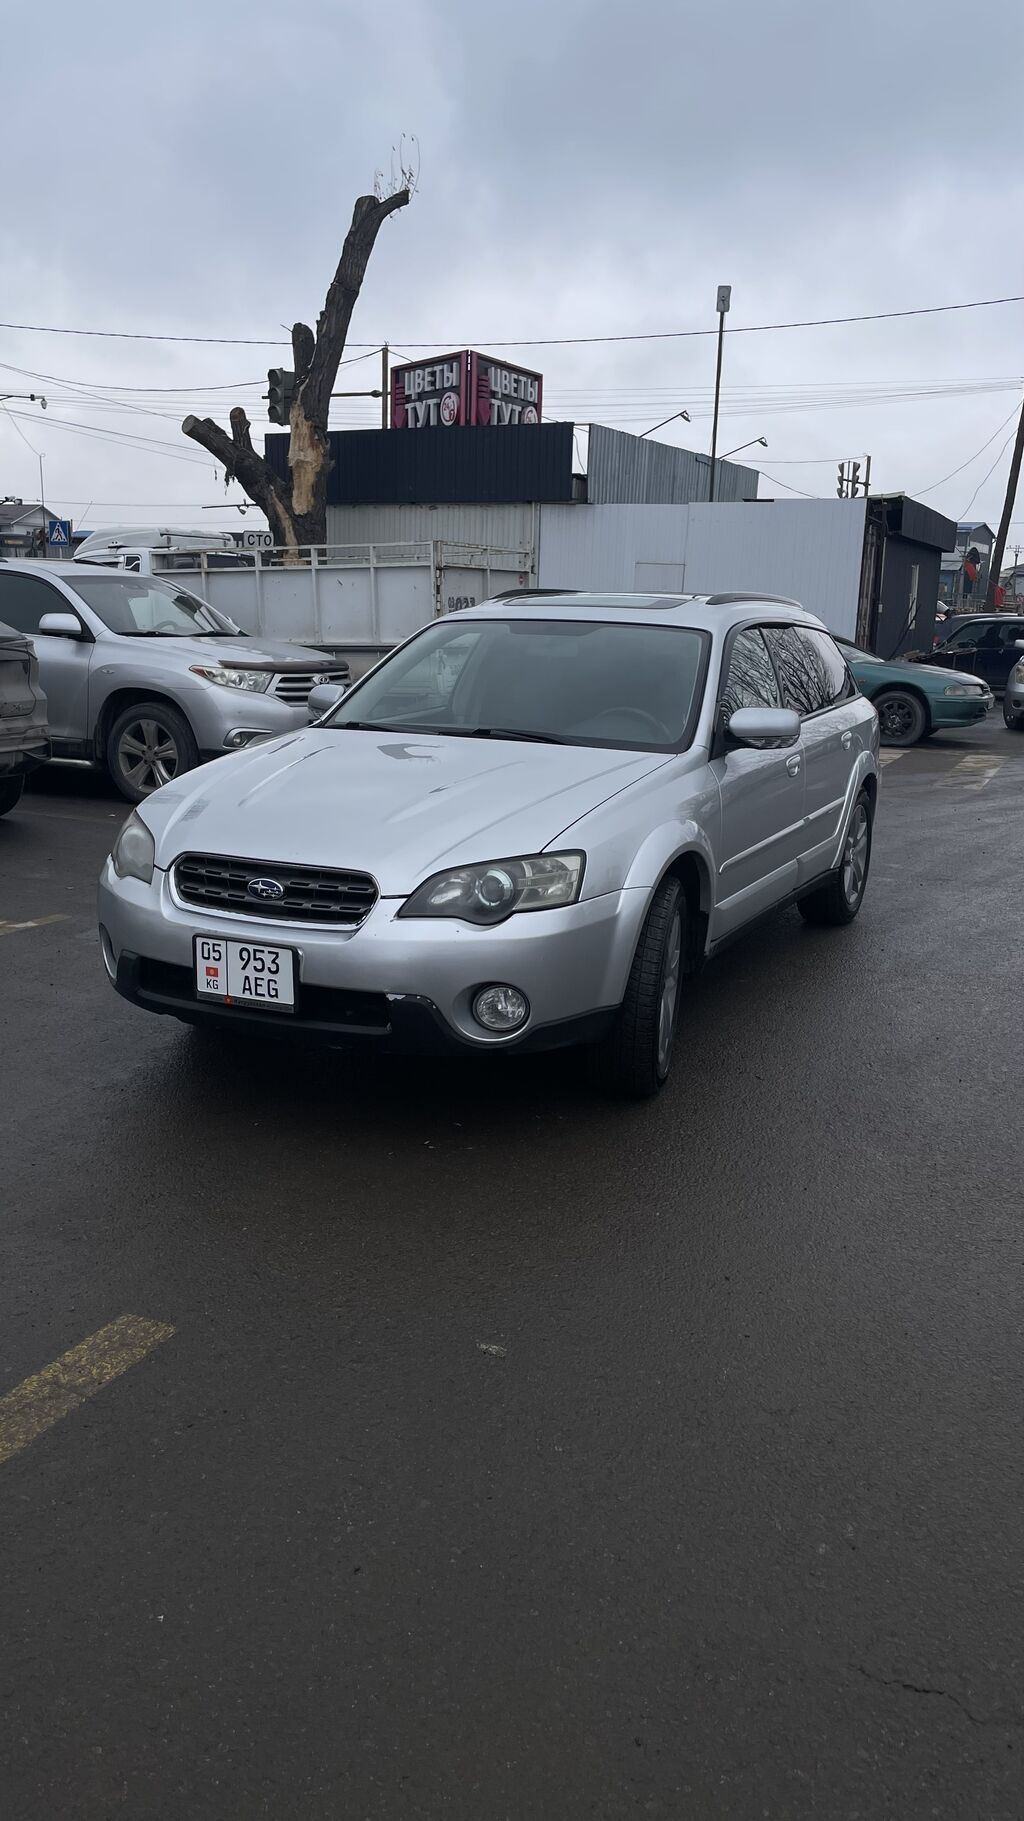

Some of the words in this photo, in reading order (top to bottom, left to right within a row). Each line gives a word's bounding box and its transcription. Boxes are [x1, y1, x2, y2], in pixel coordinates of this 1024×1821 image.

[404, 362, 459, 399] ЦВЕТЫ
[488, 367, 538, 403] ЦВЕТЫ
[404, 398, 441, 429] ТУТ
[489, 398, 522, 425] ТУТ
[247, 534, 272, 546] СТО
[201, 941, 222, 962] 05
[239, 947, 280, 975] 953
[206, 978, 219, 990] KG
[242, 975, 279, 999] AEG
